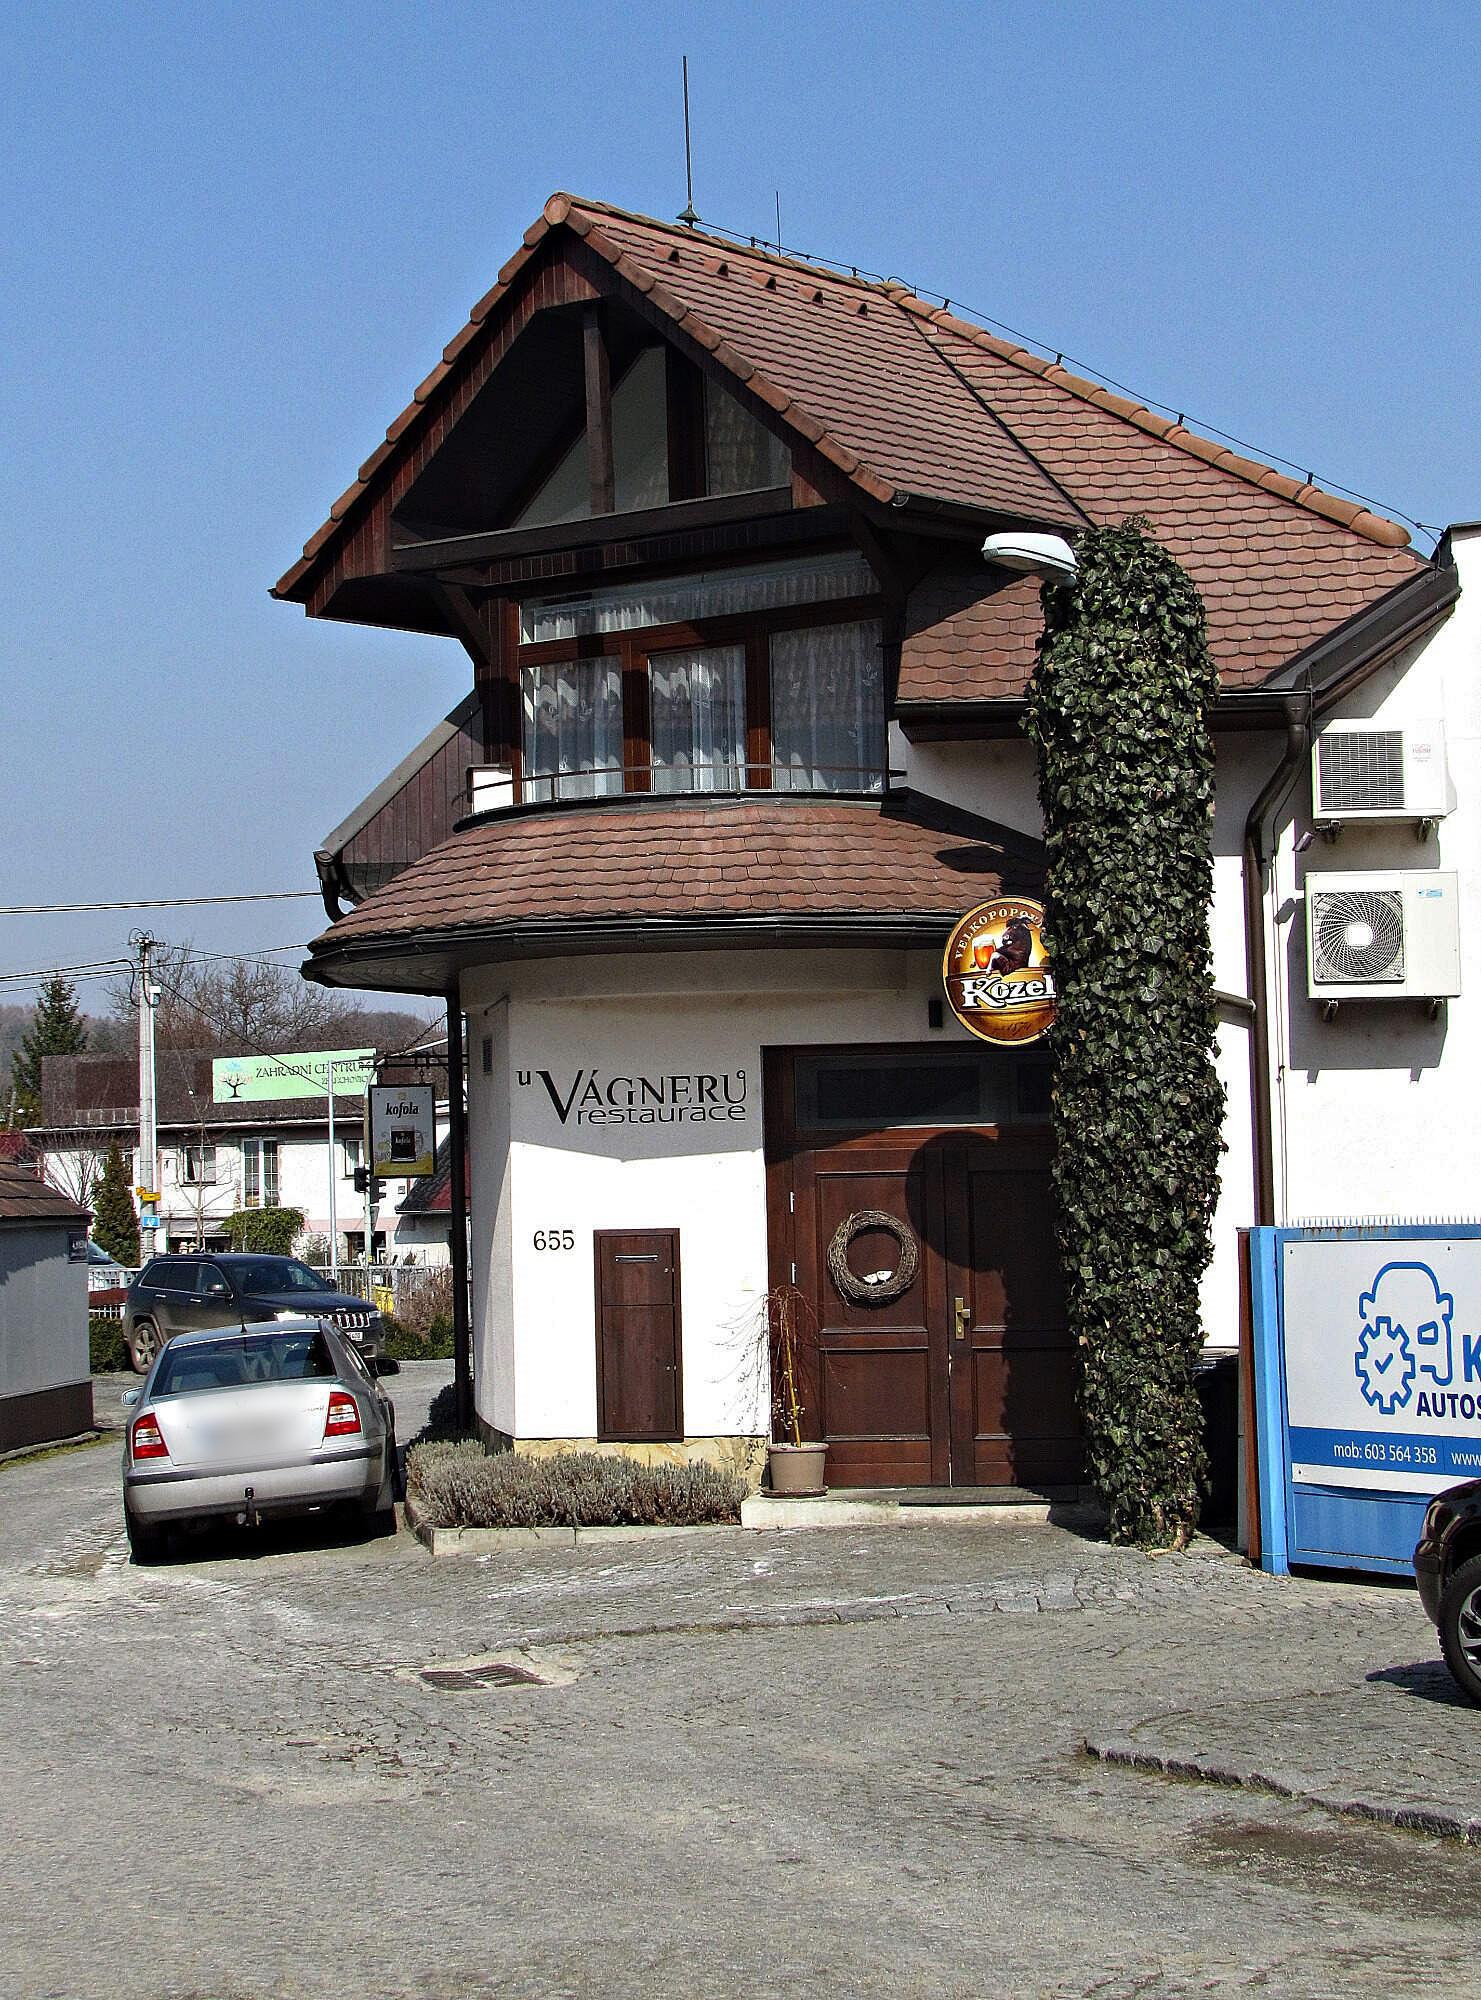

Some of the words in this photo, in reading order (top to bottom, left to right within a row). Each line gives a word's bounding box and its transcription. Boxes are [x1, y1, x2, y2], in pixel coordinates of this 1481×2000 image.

[960, 974, 1057, 1009] Kozel
[385, 1101, 419, 1119] kofola
[577, 1104, 747, 1125] restaurace
[533, 1230, 575, 1251] 655
[1333, 1441, 1362, 1459] mob:
[1364, 1443, 1386, 1461] 603
[1389, 1445, 1411, 1462] 564
[1414, 1446, 1437, 1464] 358
